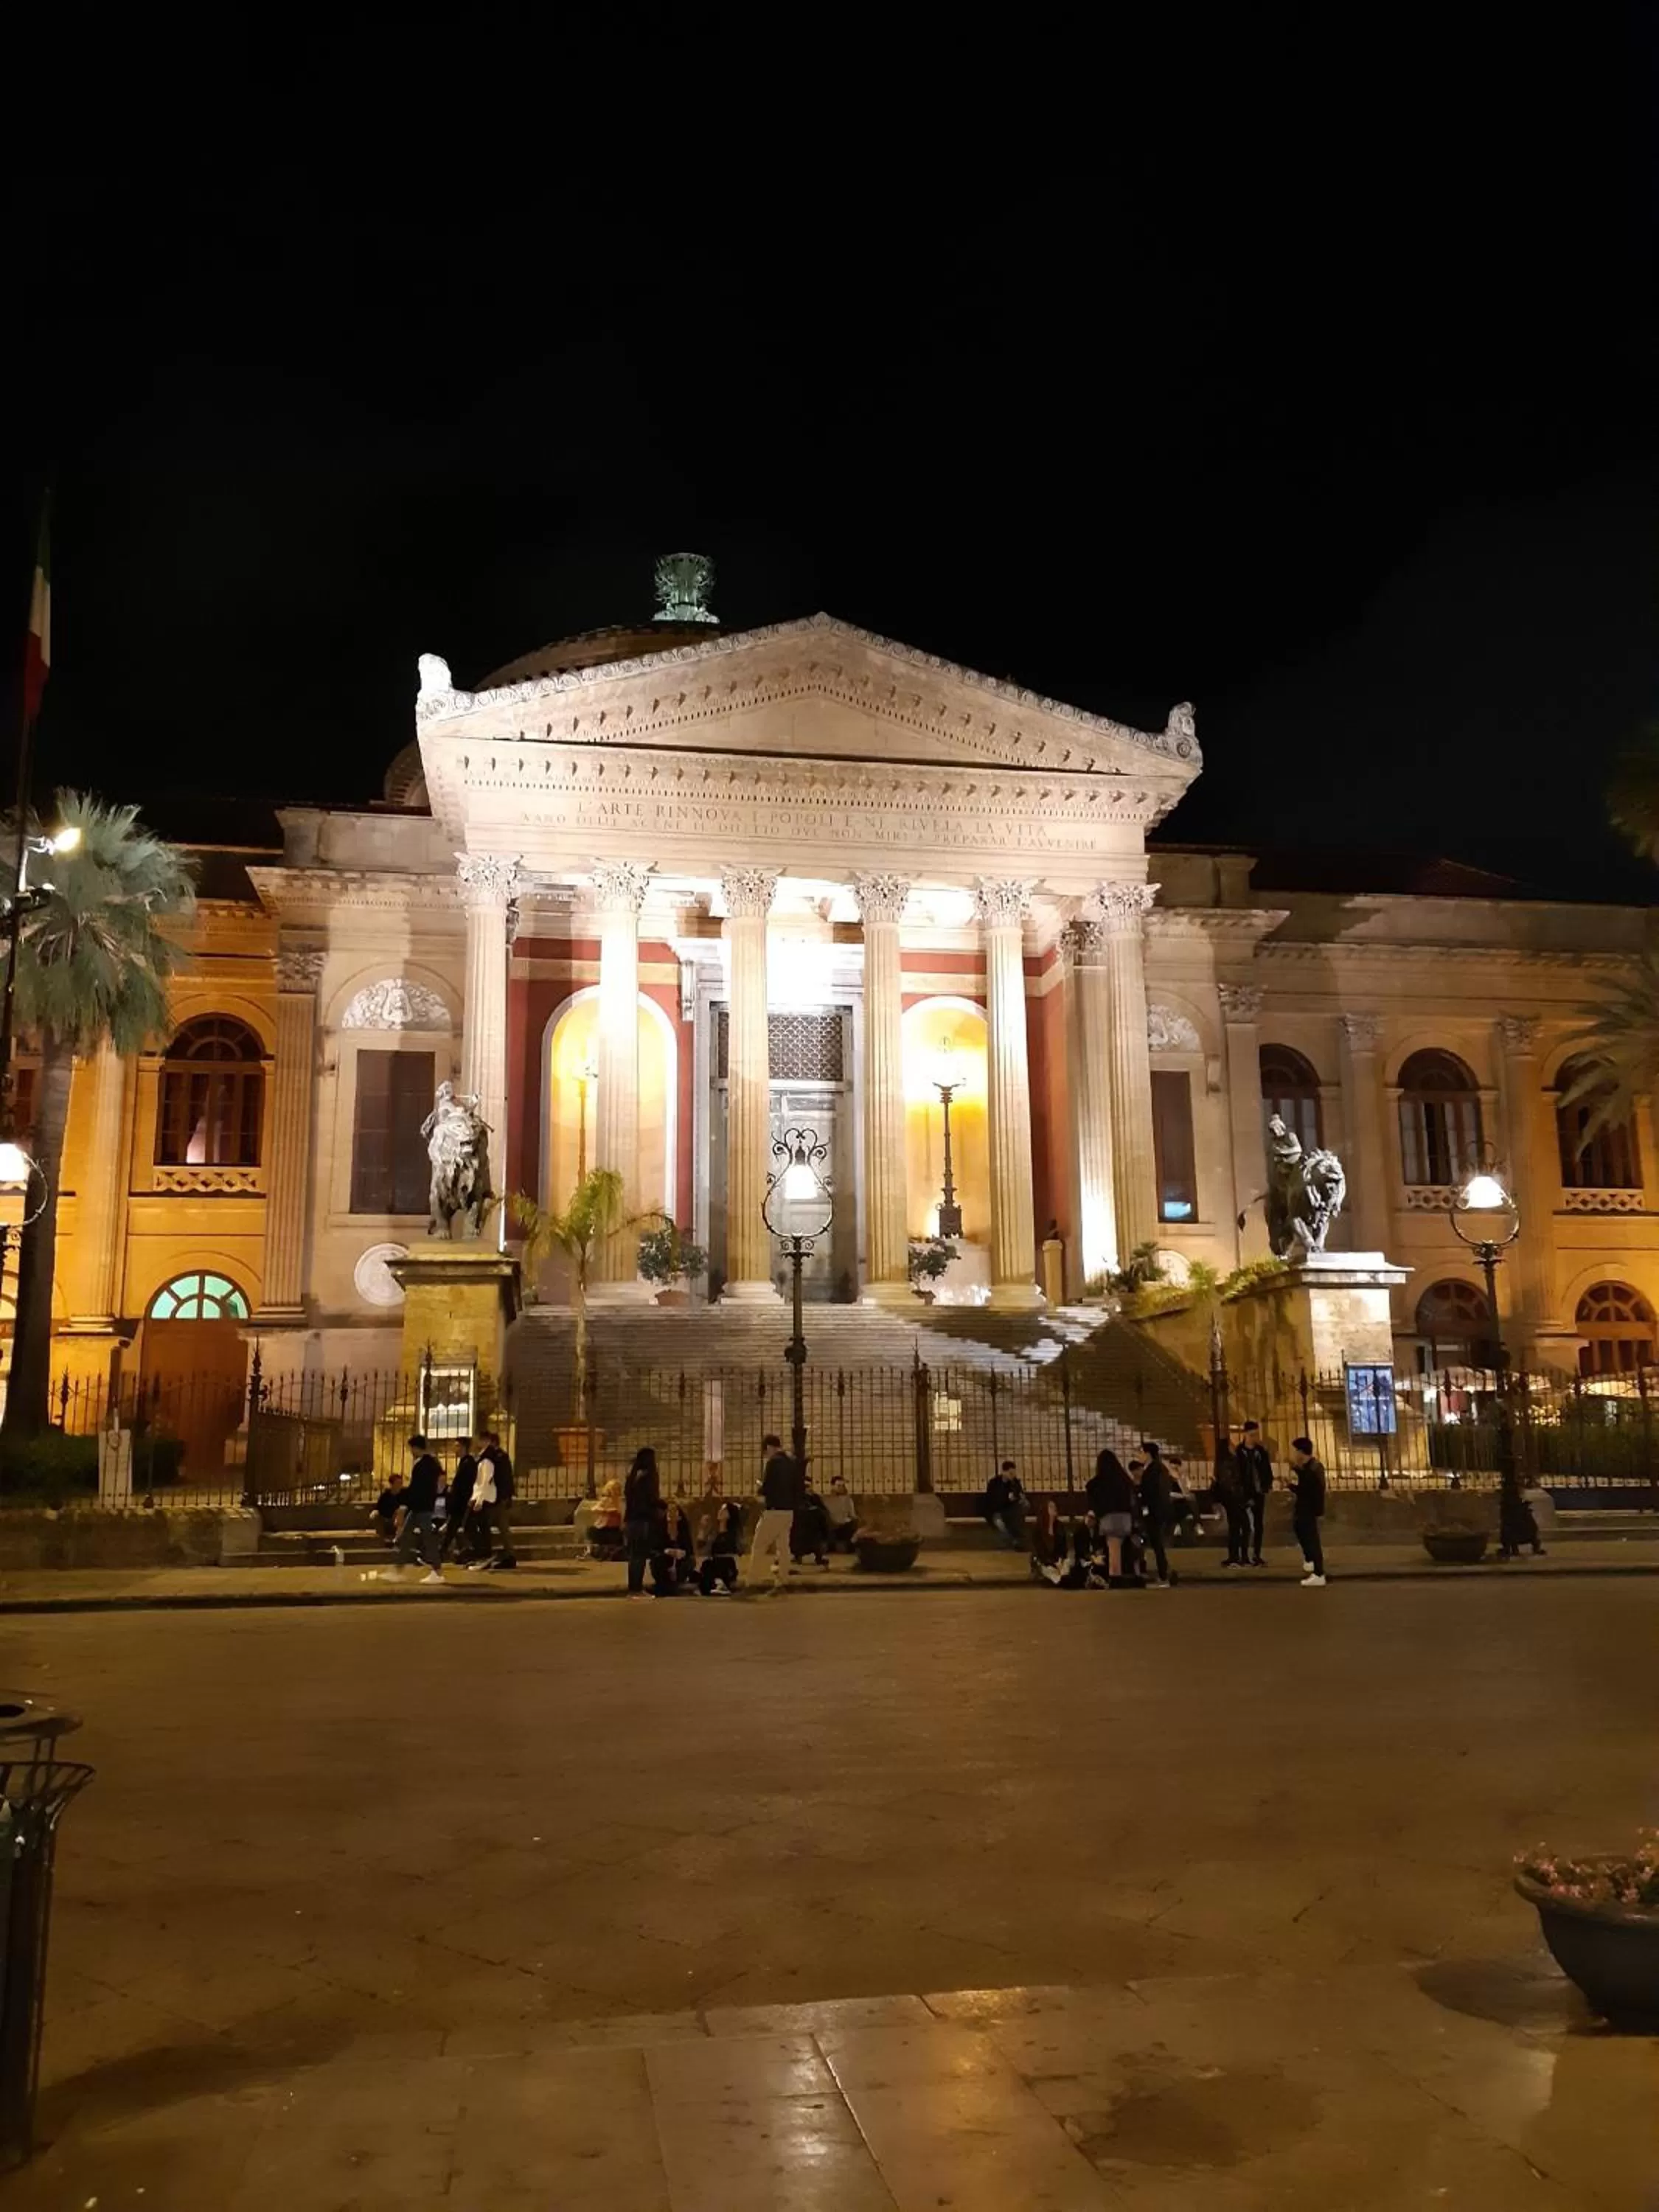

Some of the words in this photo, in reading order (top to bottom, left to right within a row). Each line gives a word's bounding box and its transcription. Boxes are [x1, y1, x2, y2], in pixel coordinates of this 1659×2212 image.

[578, 801, 644, 816] L'ARTE
[656, 804, 742, 821] RINNOVA
[771, 812, 832, 826] POPOLI
[900, 817, 963, 832] RIVELA
[975, 821, 994, 835] LA
[1005, 822, 1046, 837] VITA
